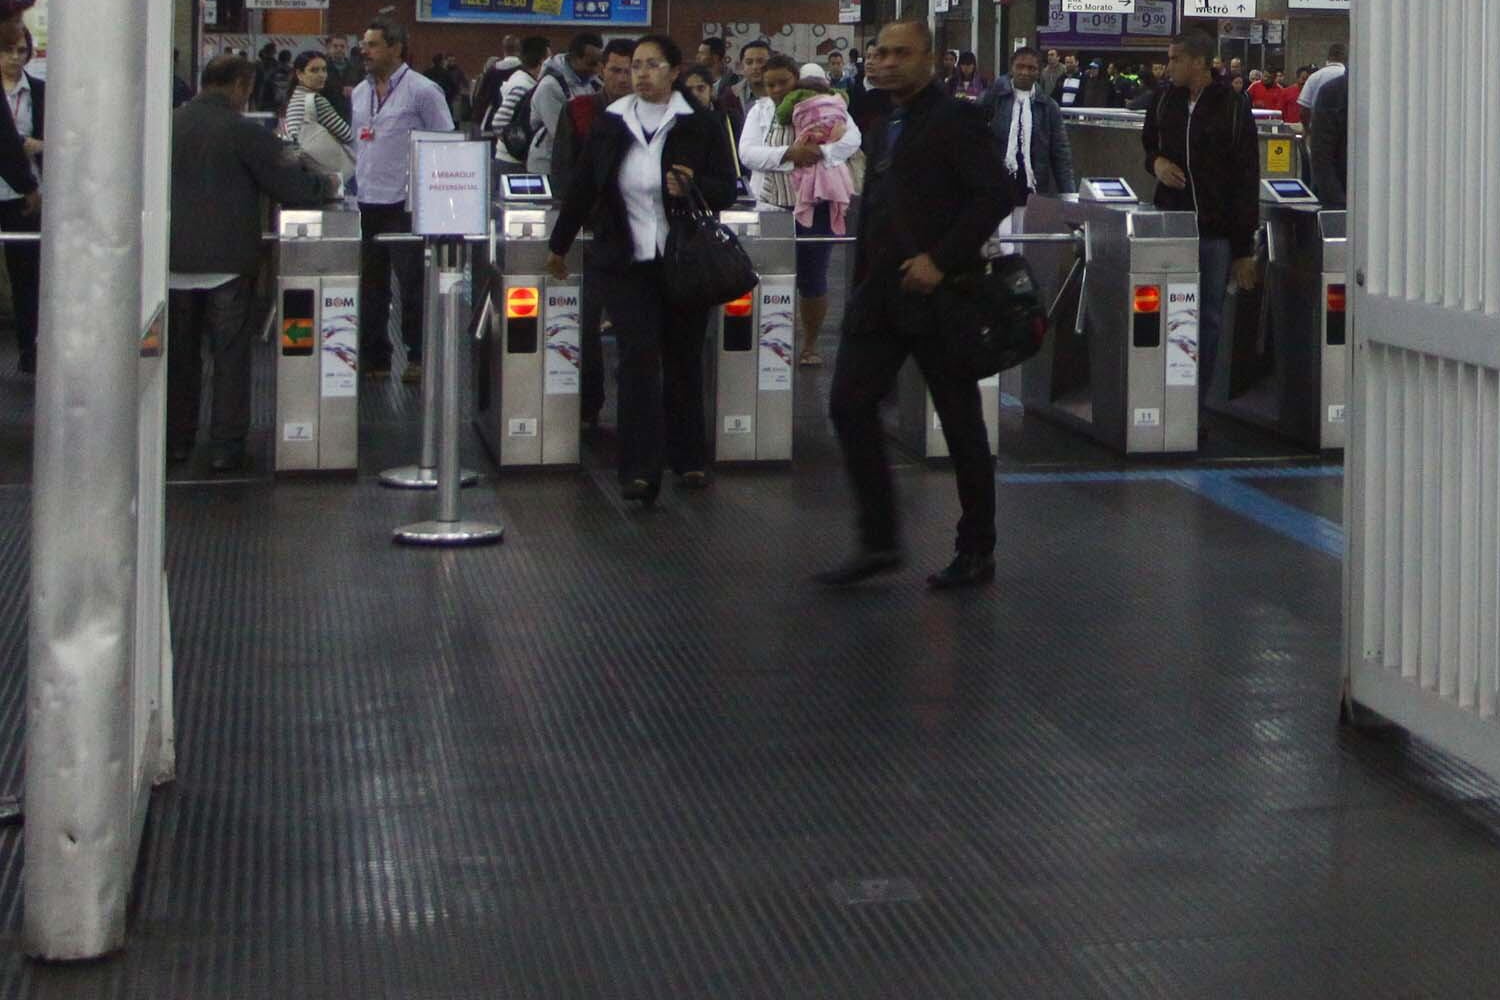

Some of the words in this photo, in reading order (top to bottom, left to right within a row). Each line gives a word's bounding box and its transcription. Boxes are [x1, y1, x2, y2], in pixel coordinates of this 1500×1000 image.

[1067, 3, 1084, 11] Fco
[324, 297, 355, 308] BOM
[548, 296, 578, 307] BOM
[763, 294, 791, 305] BOM
[1169, 293, 1196, 303] BOM
